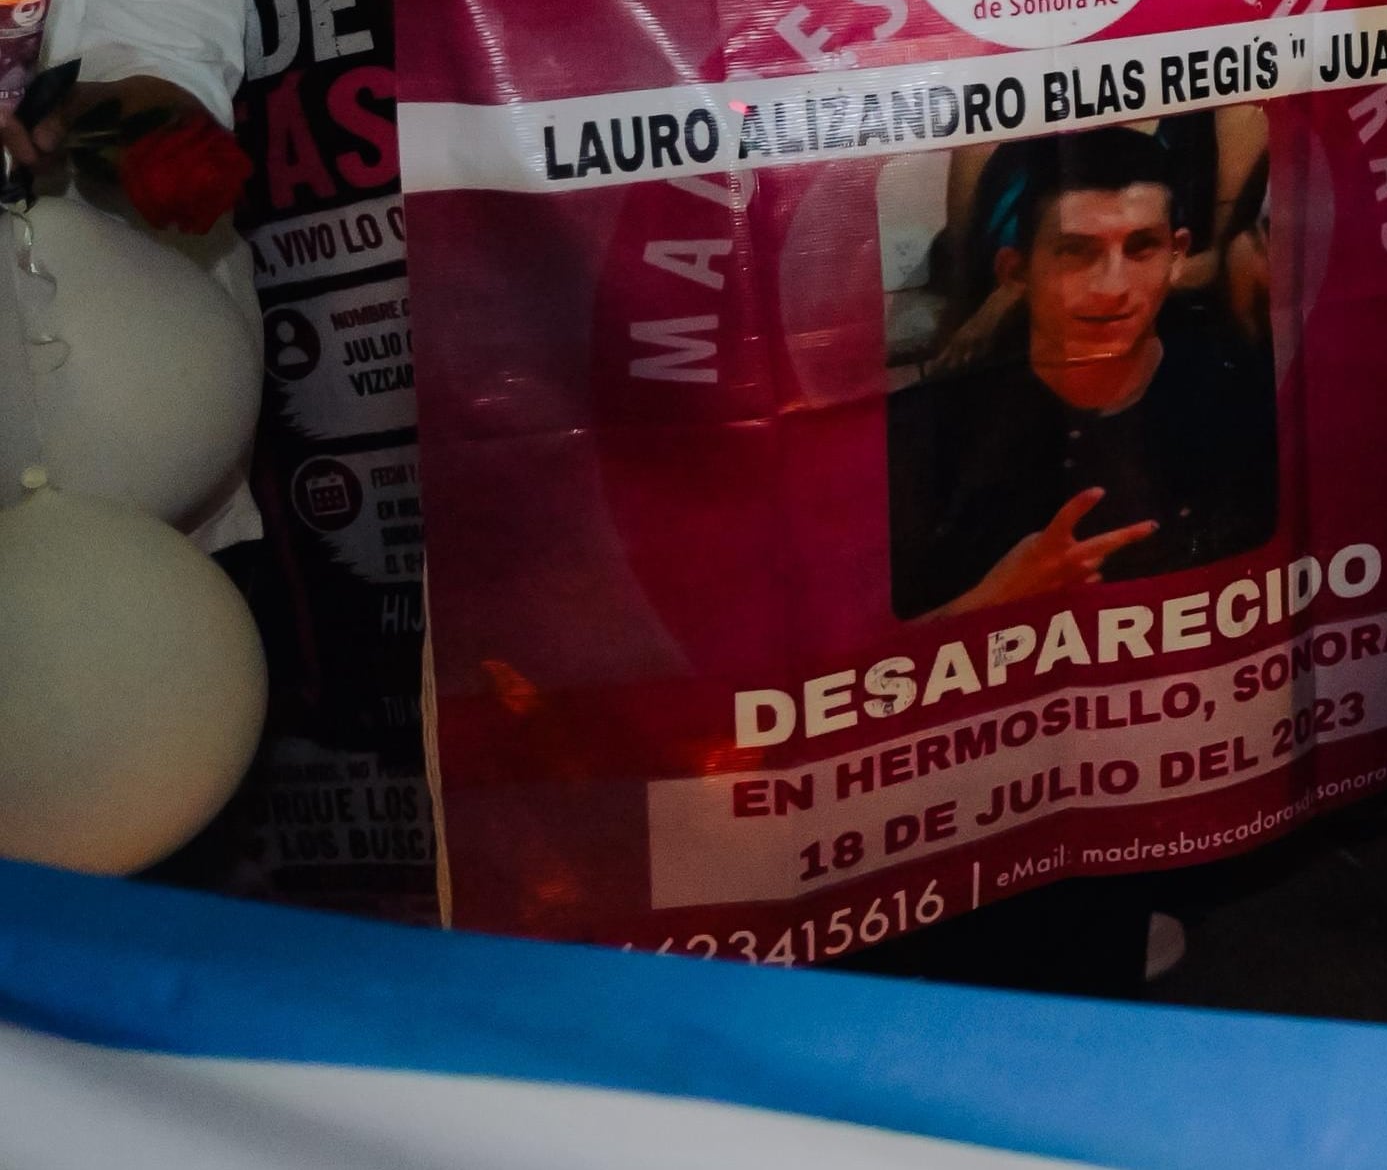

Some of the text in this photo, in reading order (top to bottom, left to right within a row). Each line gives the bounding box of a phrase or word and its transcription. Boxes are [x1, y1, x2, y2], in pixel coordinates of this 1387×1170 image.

[543, 107, 720, 181] LAURO
[738, 76, 1027, 160] ALIZANDRO
[1043, 58, 1145, 123] BLAS
[272, 222, 338, 268] VIVO
[340, 213, 383, 254] LO
[343, 332, 402, 366] JULIO
[734, 542, 1383, 749] DESAPARECIDO
[732, 773, 814, 818] EN
[835, 682, 1216, 800] HERMOSILLO,
[798, 692, 1365, 882] 18 DE JULIO DEL 2023
[622, 879, 945, 967] 23415616
